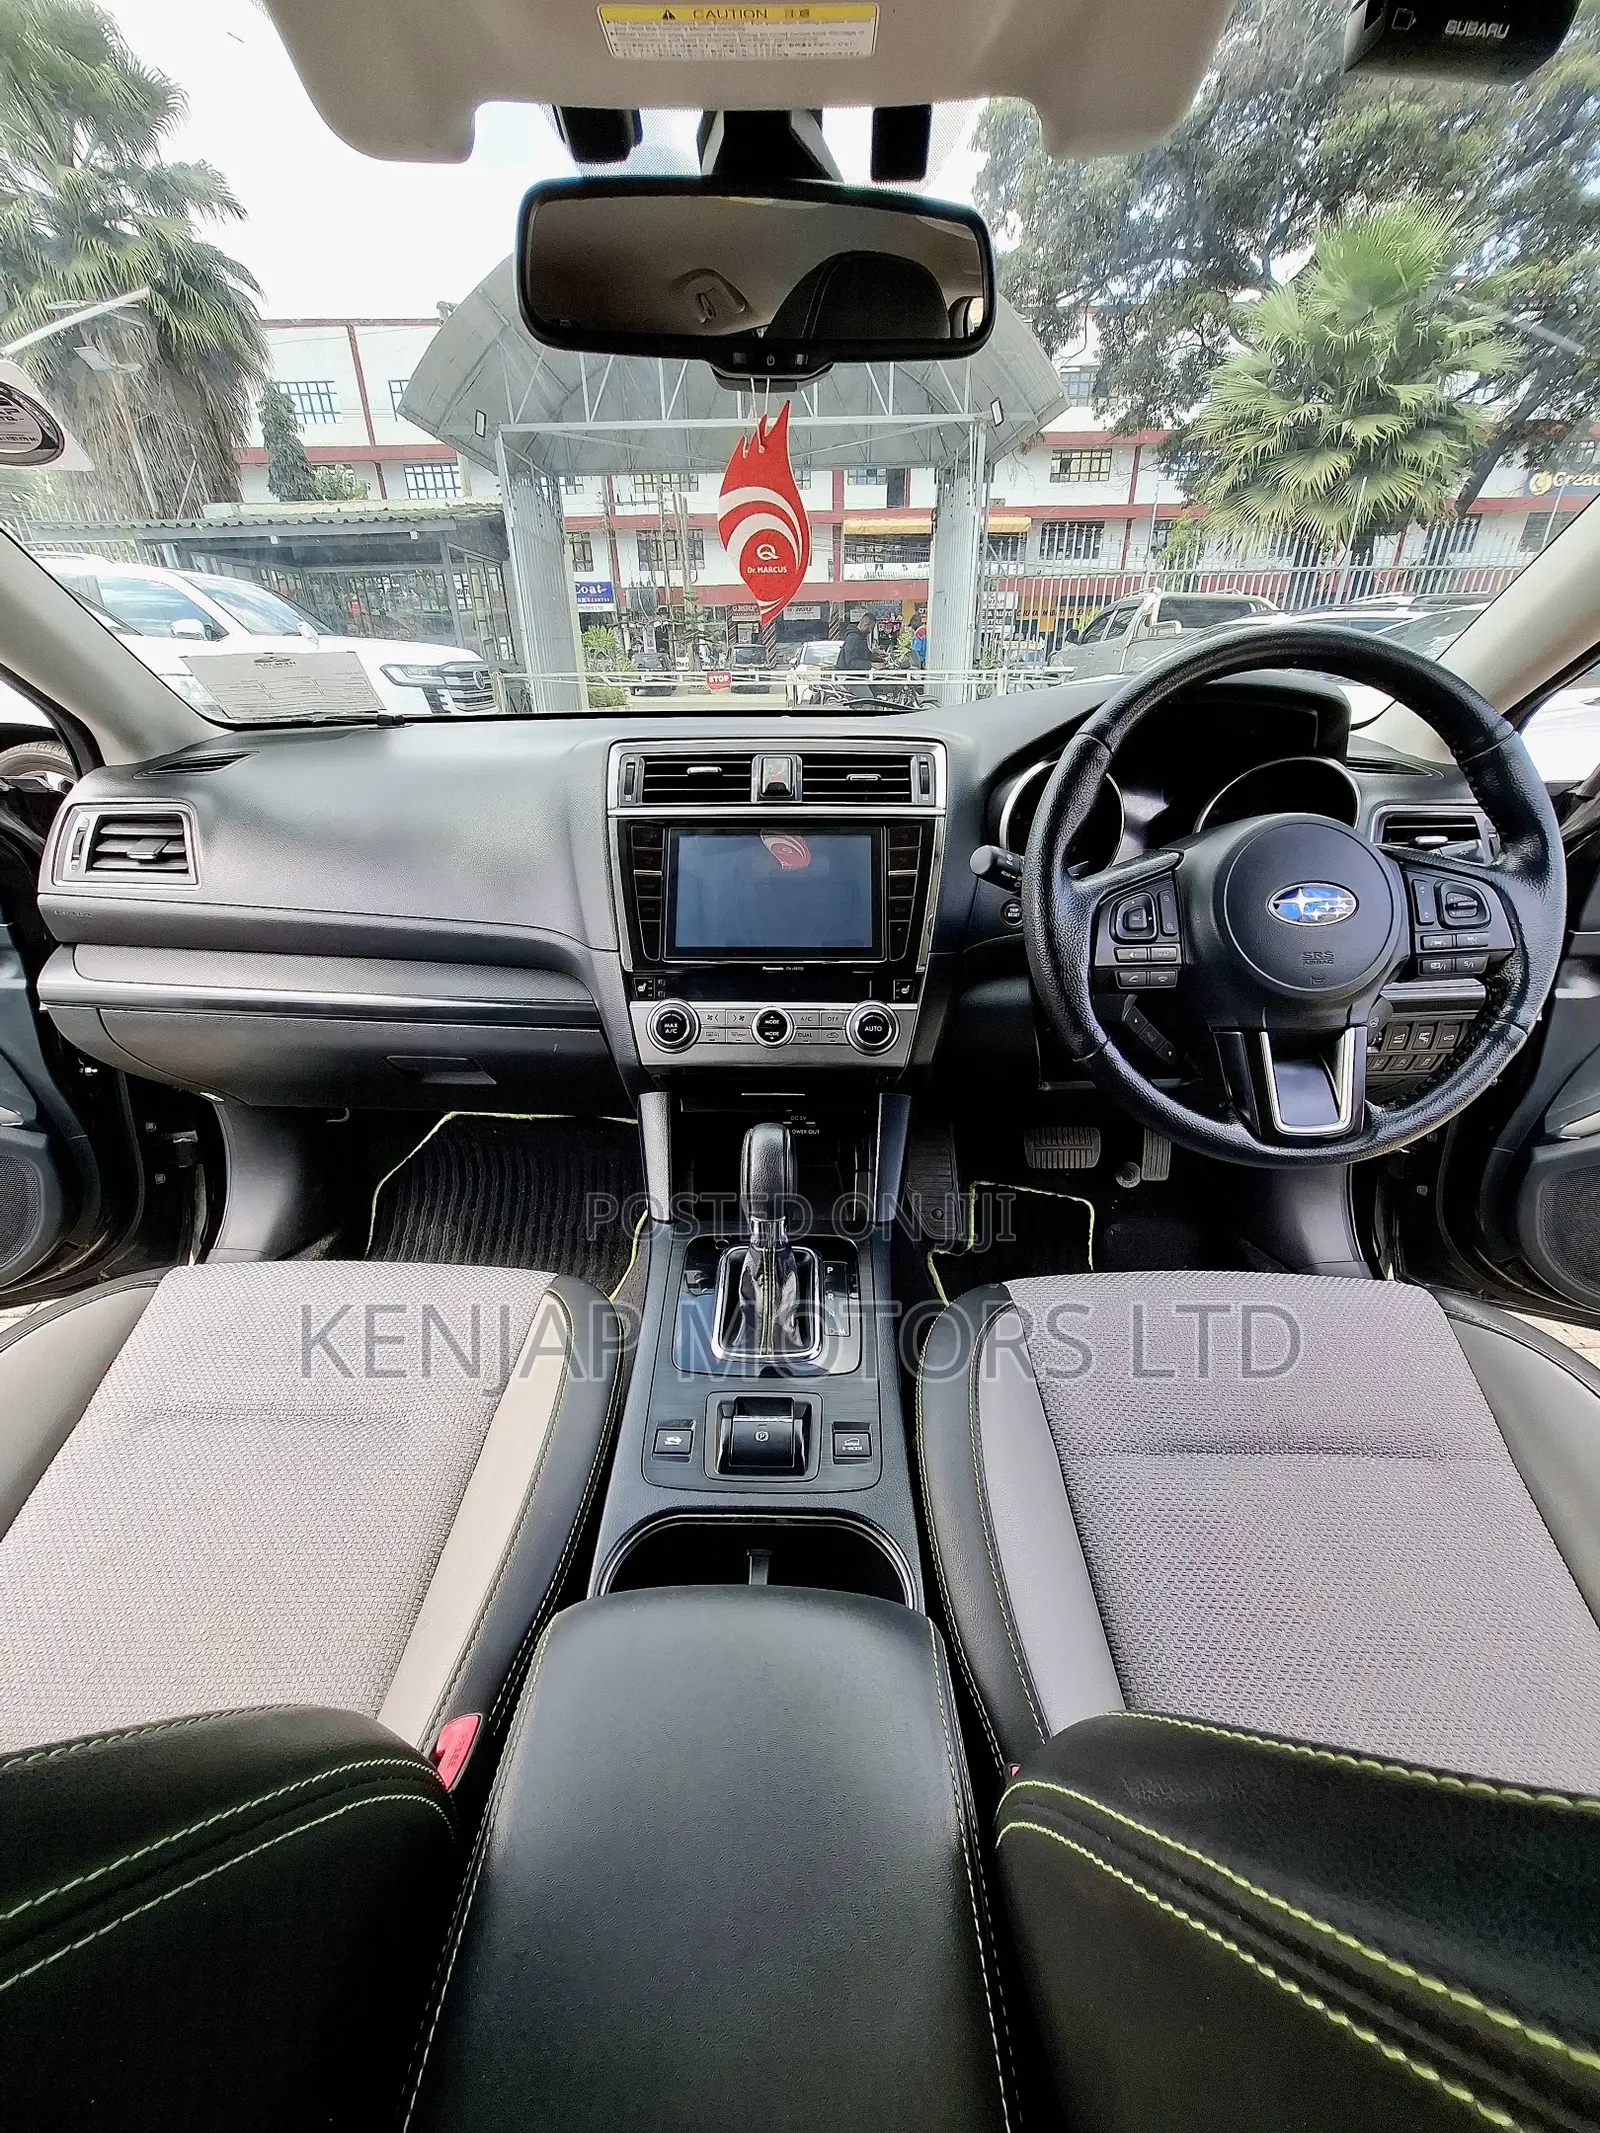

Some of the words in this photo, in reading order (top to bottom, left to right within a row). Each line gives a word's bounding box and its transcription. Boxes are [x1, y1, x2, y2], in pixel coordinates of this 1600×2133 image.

[693, 9, 768, 19] CAUTION
[1444, 19, 1510, 39] SUBARU
[757, 566, 788, 574] MARCUS
[708, 675, 729, 683] STOP
[1302, 951, 1334, 960] SRS
[827, 1266, 834, 1274] P
[827, 1293, 835, 1301] R
